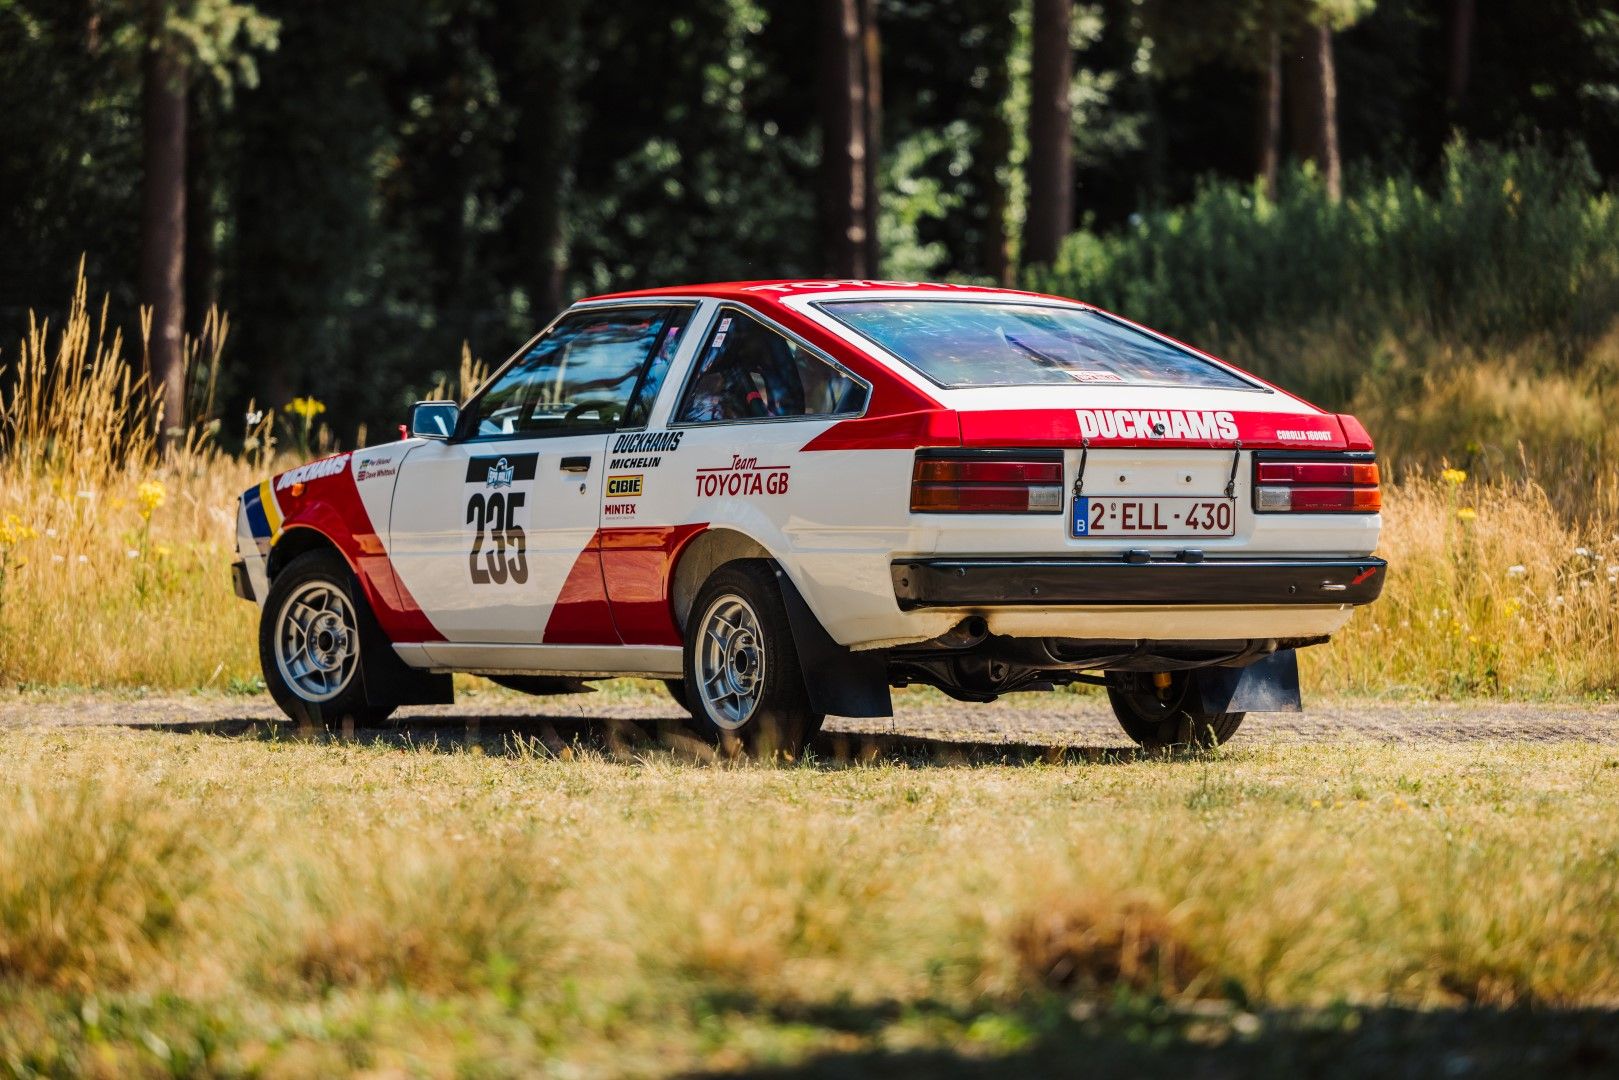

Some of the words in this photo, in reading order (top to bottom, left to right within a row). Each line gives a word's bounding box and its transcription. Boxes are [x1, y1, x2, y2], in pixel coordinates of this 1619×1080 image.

[1076, 410, 1239, 440] DUCKHAMS
[613, 432, 684, 454] DUCKHAMS
[1276, 429, 1307, 441] COROLLA
[277, 453, 351, 491] DUCKHAMS
[610, 457, 661, 469] MICHELIN
[732, 454, 757, 471] Team
[696, 473, 763, 497] TOYOTA
[766, 472, 789, 495] GB
[604, 504, 636, 515] MINTEX
[1077, 519, 1086, 532] B
[467, 492, 528, 584] 235
